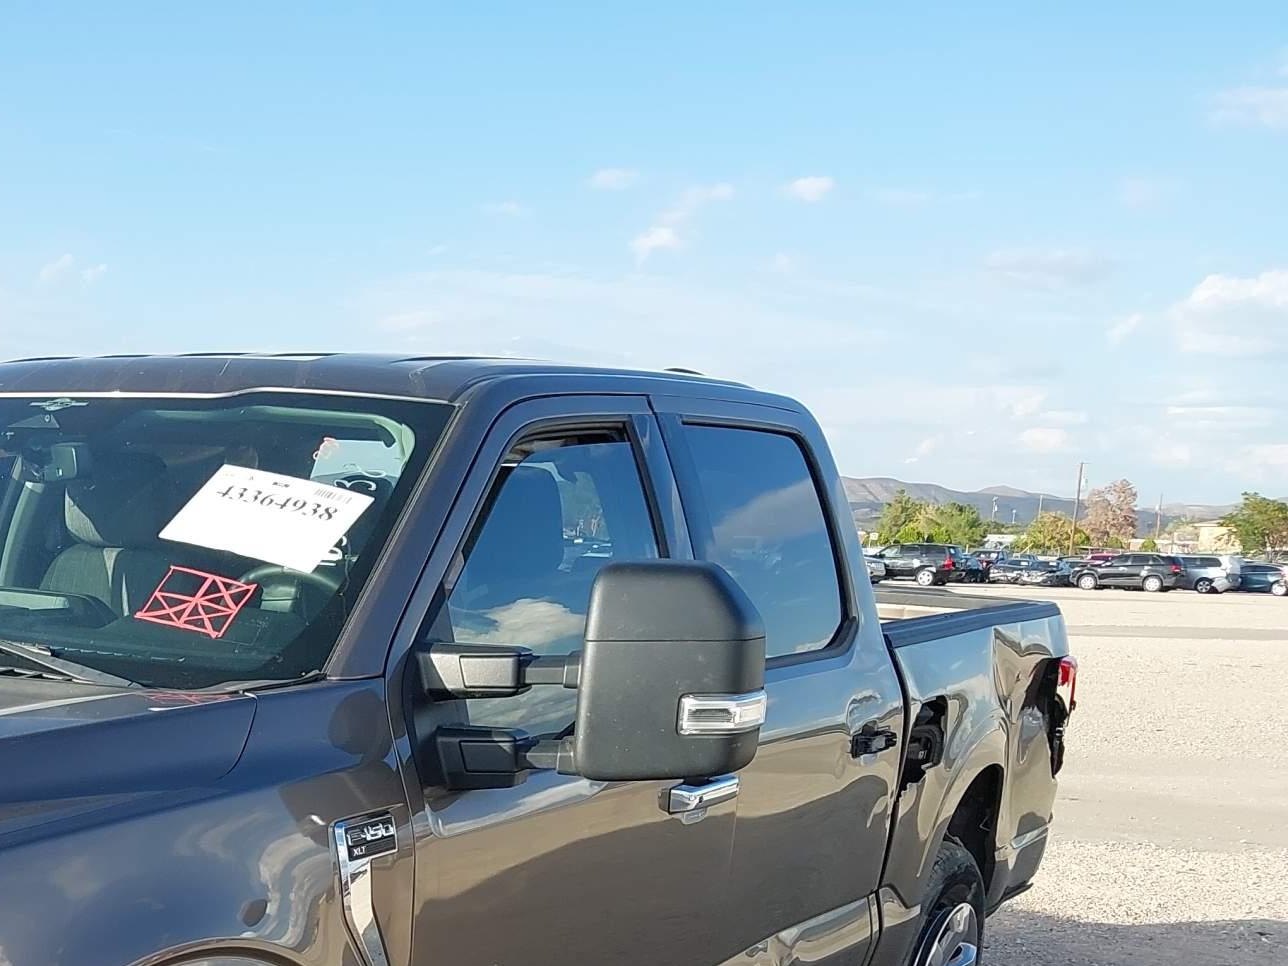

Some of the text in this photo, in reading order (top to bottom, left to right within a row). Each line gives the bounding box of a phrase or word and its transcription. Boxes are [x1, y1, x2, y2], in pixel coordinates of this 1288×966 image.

[216, 484, 338, 521] 43364938
[346, 822, 395, 846] F-150
[353, 845, 367, 857] XLT
